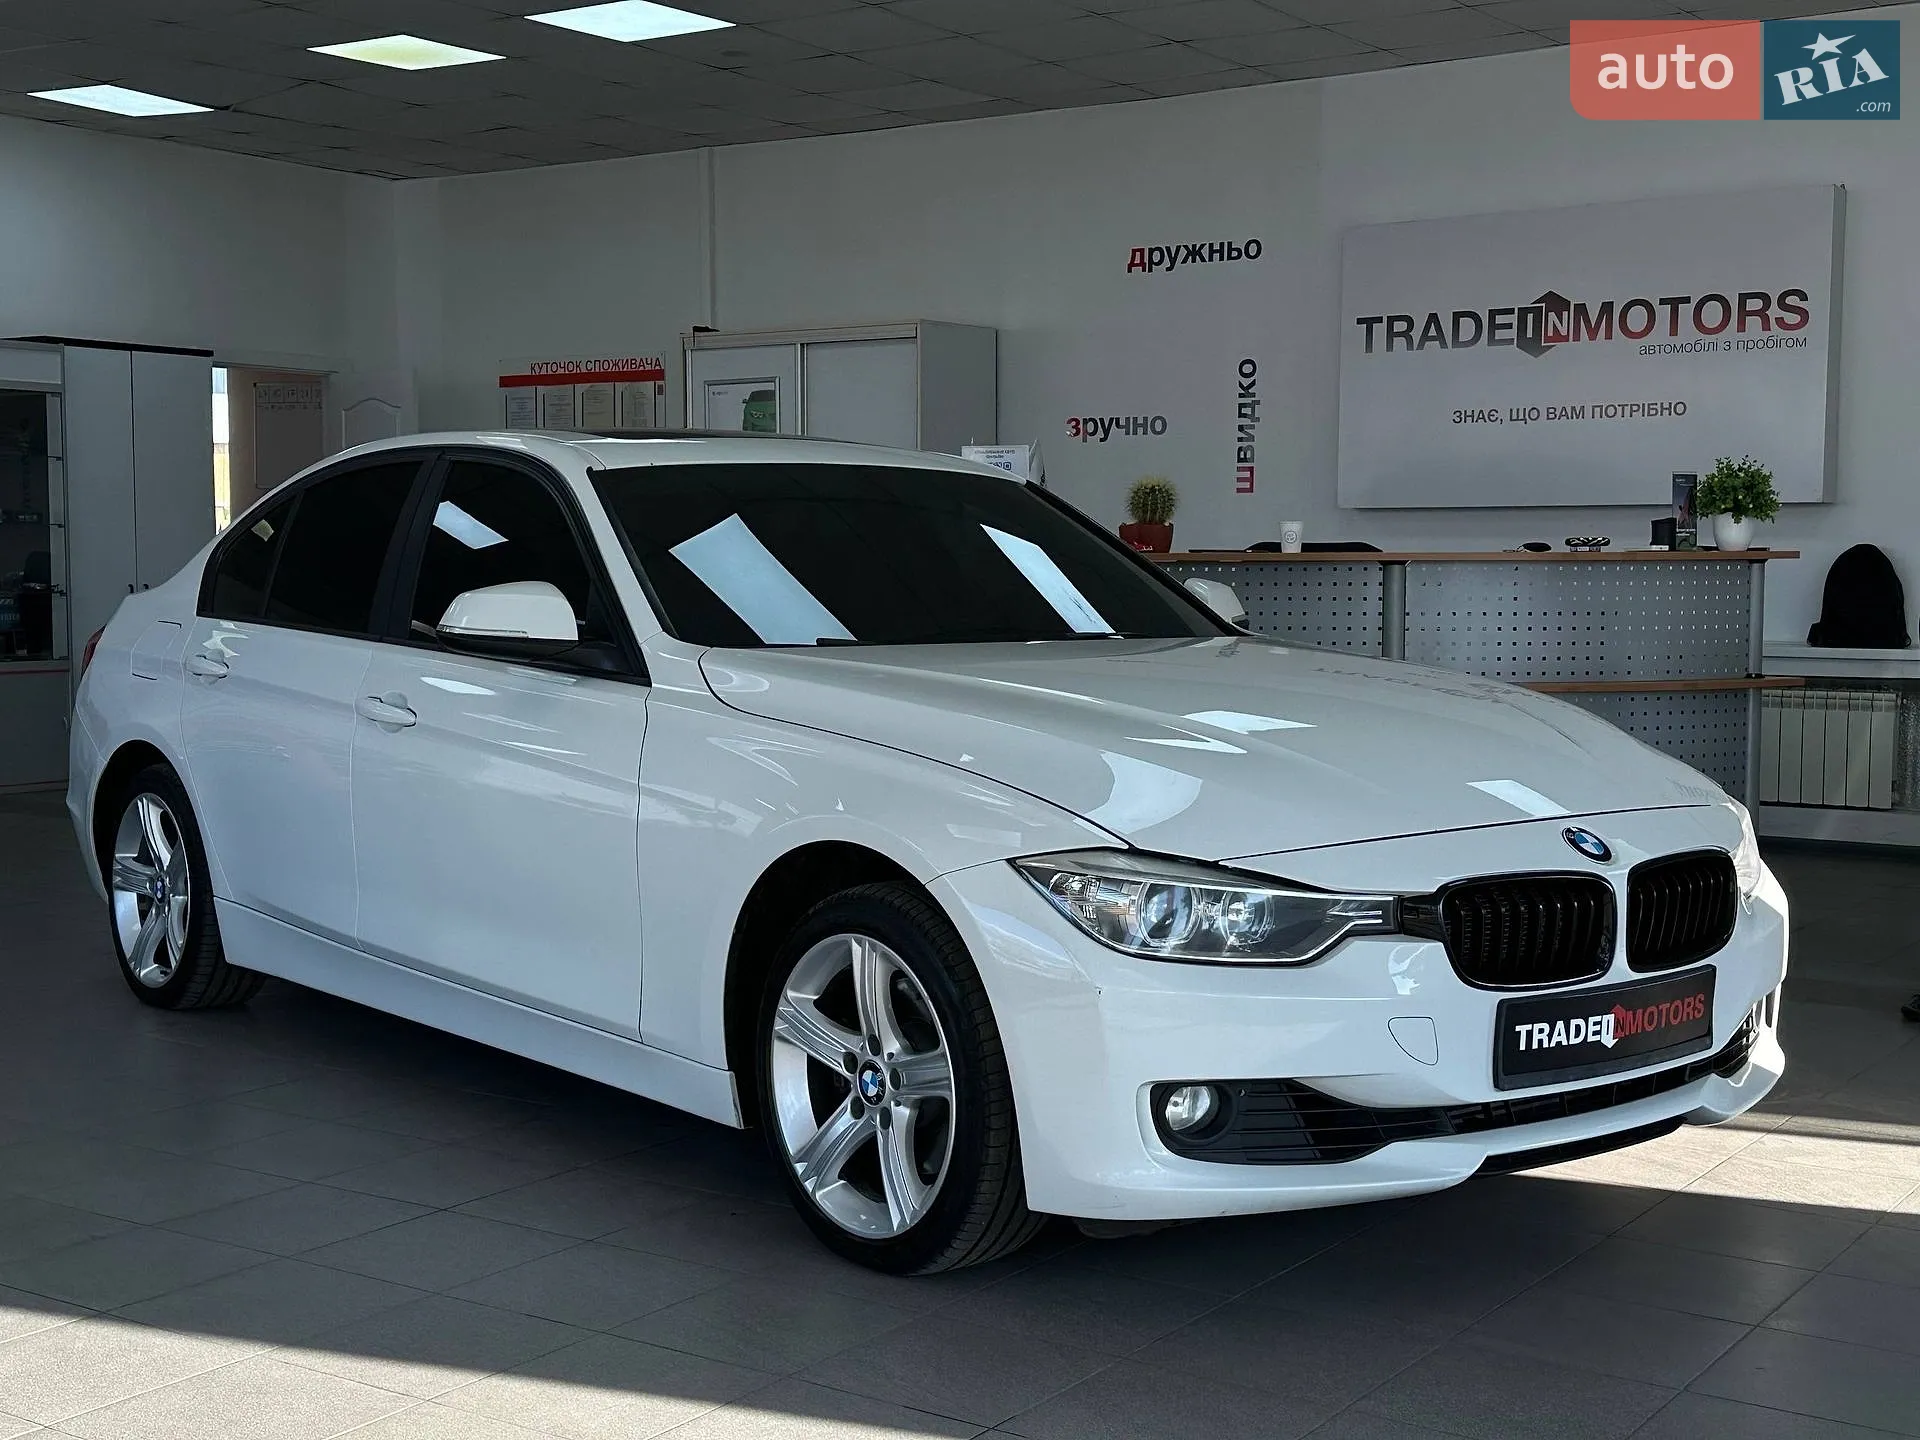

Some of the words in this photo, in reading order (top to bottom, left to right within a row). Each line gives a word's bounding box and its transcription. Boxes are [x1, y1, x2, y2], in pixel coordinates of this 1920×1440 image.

[1126, 238, 1263, 274] дружньо
[1639, 338, 1718, 356] автомобілі
[1722, 341, 1732, 351] з
[1736, 335, 1808, 353] пробігом
[530, 359, 582, 375] КУТОЧОК
[585, 356, 662, 372] СПОЖИВАЧА
[1235, 357, 1261, 494] швидко
[1452, 408, 1504, 425] ЗНАЄ,
[1509, 407, 1541, 425] ЩО
[1546, 405, 1586, 421] ВАМ
[1591, 401, 1688, 419] ПОТРІБНО
[1066, 415, 1168, 443] зручно
